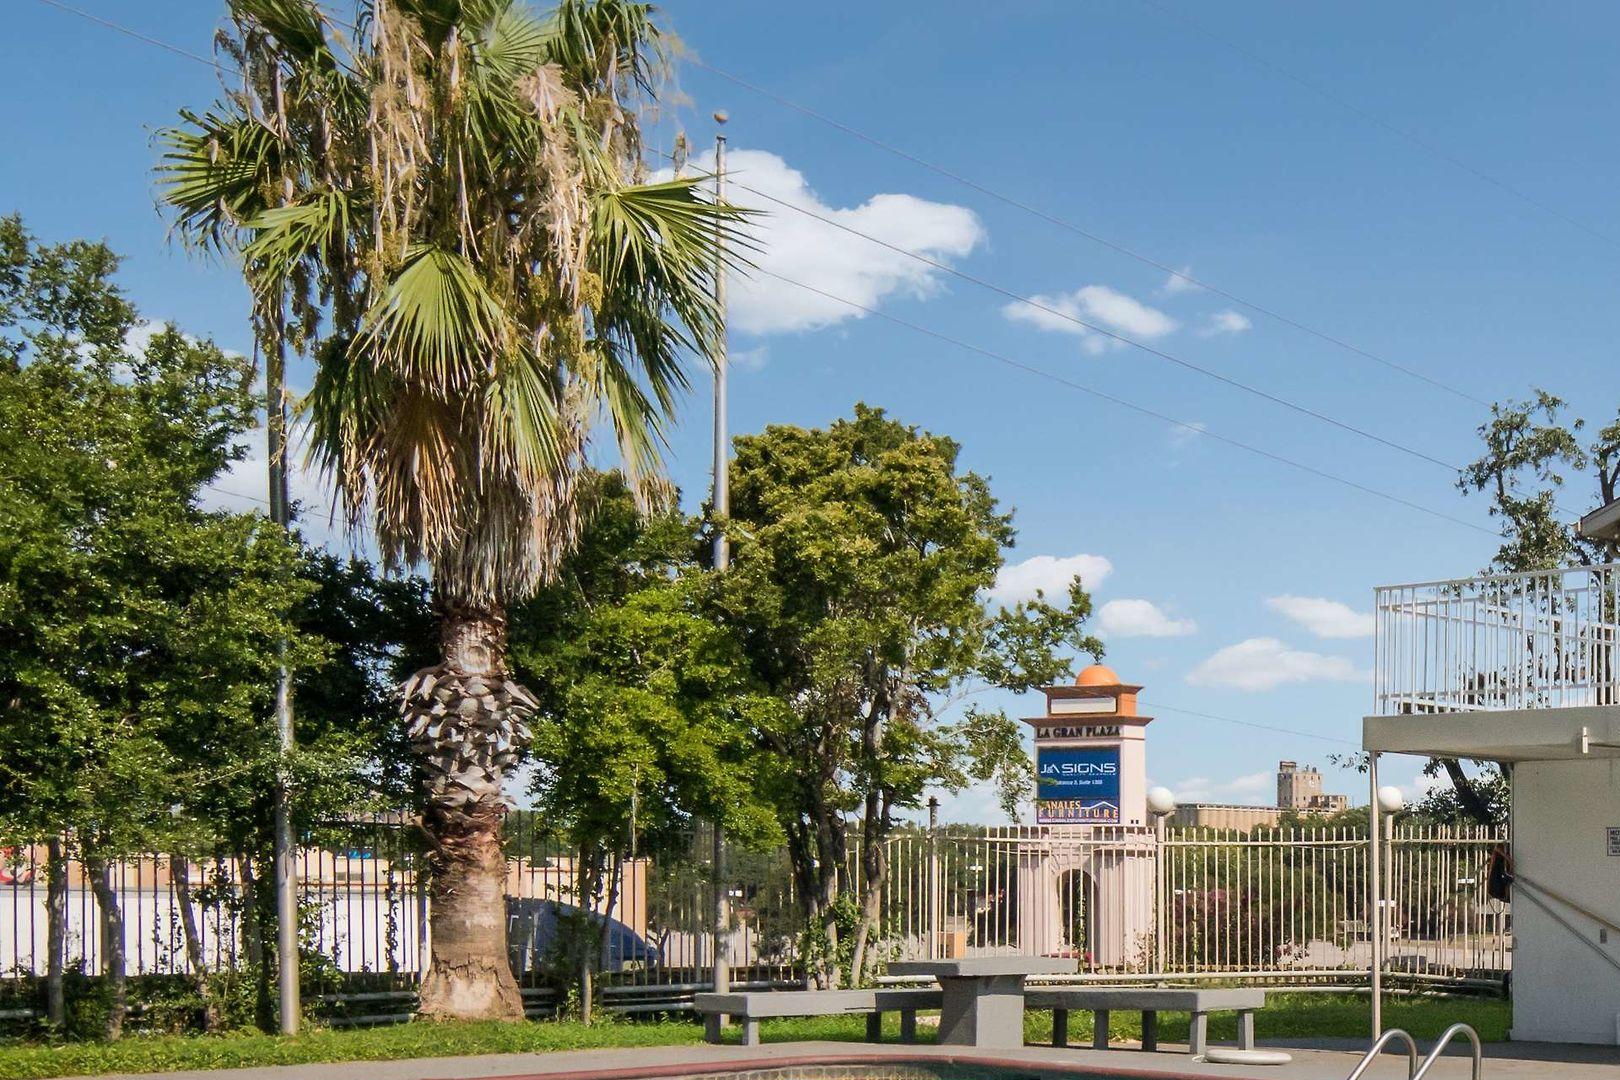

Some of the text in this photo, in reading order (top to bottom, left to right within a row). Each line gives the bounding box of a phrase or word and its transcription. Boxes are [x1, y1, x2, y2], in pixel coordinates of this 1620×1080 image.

[1037, 725, 1120, 738] LA GRAN PLAZA
[1061, 762, 1116, 774] SIGNS
[1038, 808, 1119, 819] FURNITURE
